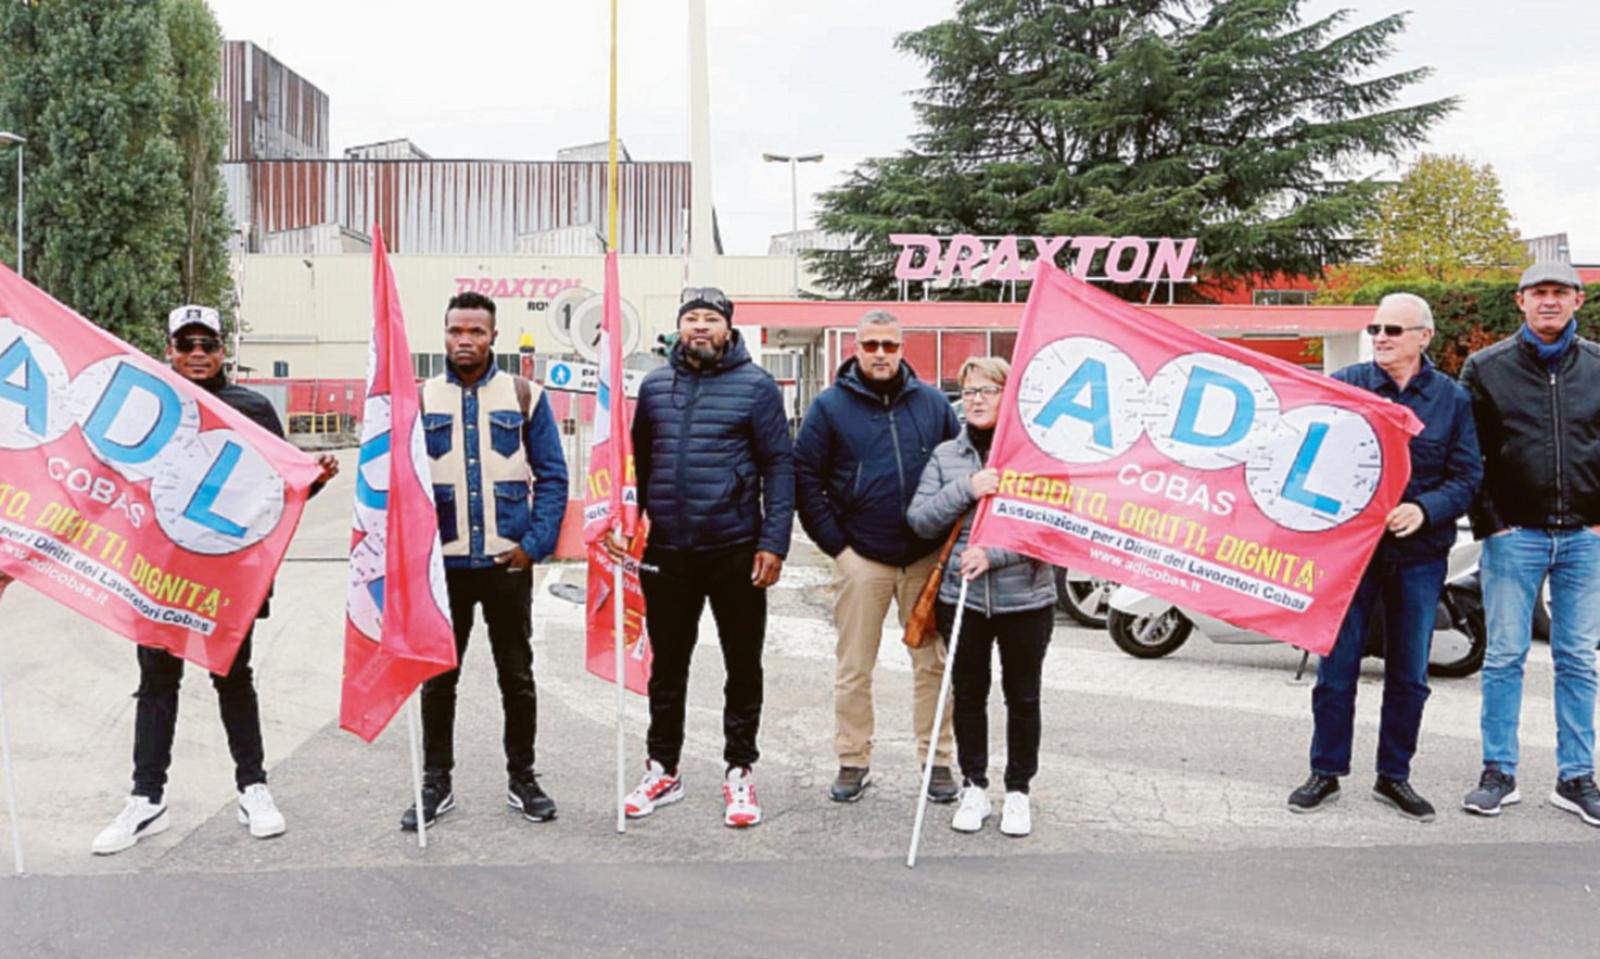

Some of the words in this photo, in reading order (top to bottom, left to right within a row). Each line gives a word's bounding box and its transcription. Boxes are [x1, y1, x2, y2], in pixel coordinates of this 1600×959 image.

[889, 234, 1197, 282] DRAXTON
[48, 457, 146, 528] COBAS
[1117, 463, 1235, 516] COBAS
[34, 535, 75, 564] Diritti
[75, 554, 97, 578] dei
[99, 570, 162, 619] Lavoratori
[163, 609, 210, 632] Cobas
[997, 501, 1089, 536] Associazione
[1090, 528, 1114, 544] per
[1124, 538, 1160, 561] Diritti
[1163, 552, 1186, 569] dei
[1188, 560, 1260, 595] Lavoratori
[1262, 586, 1306, 611] Cobas
